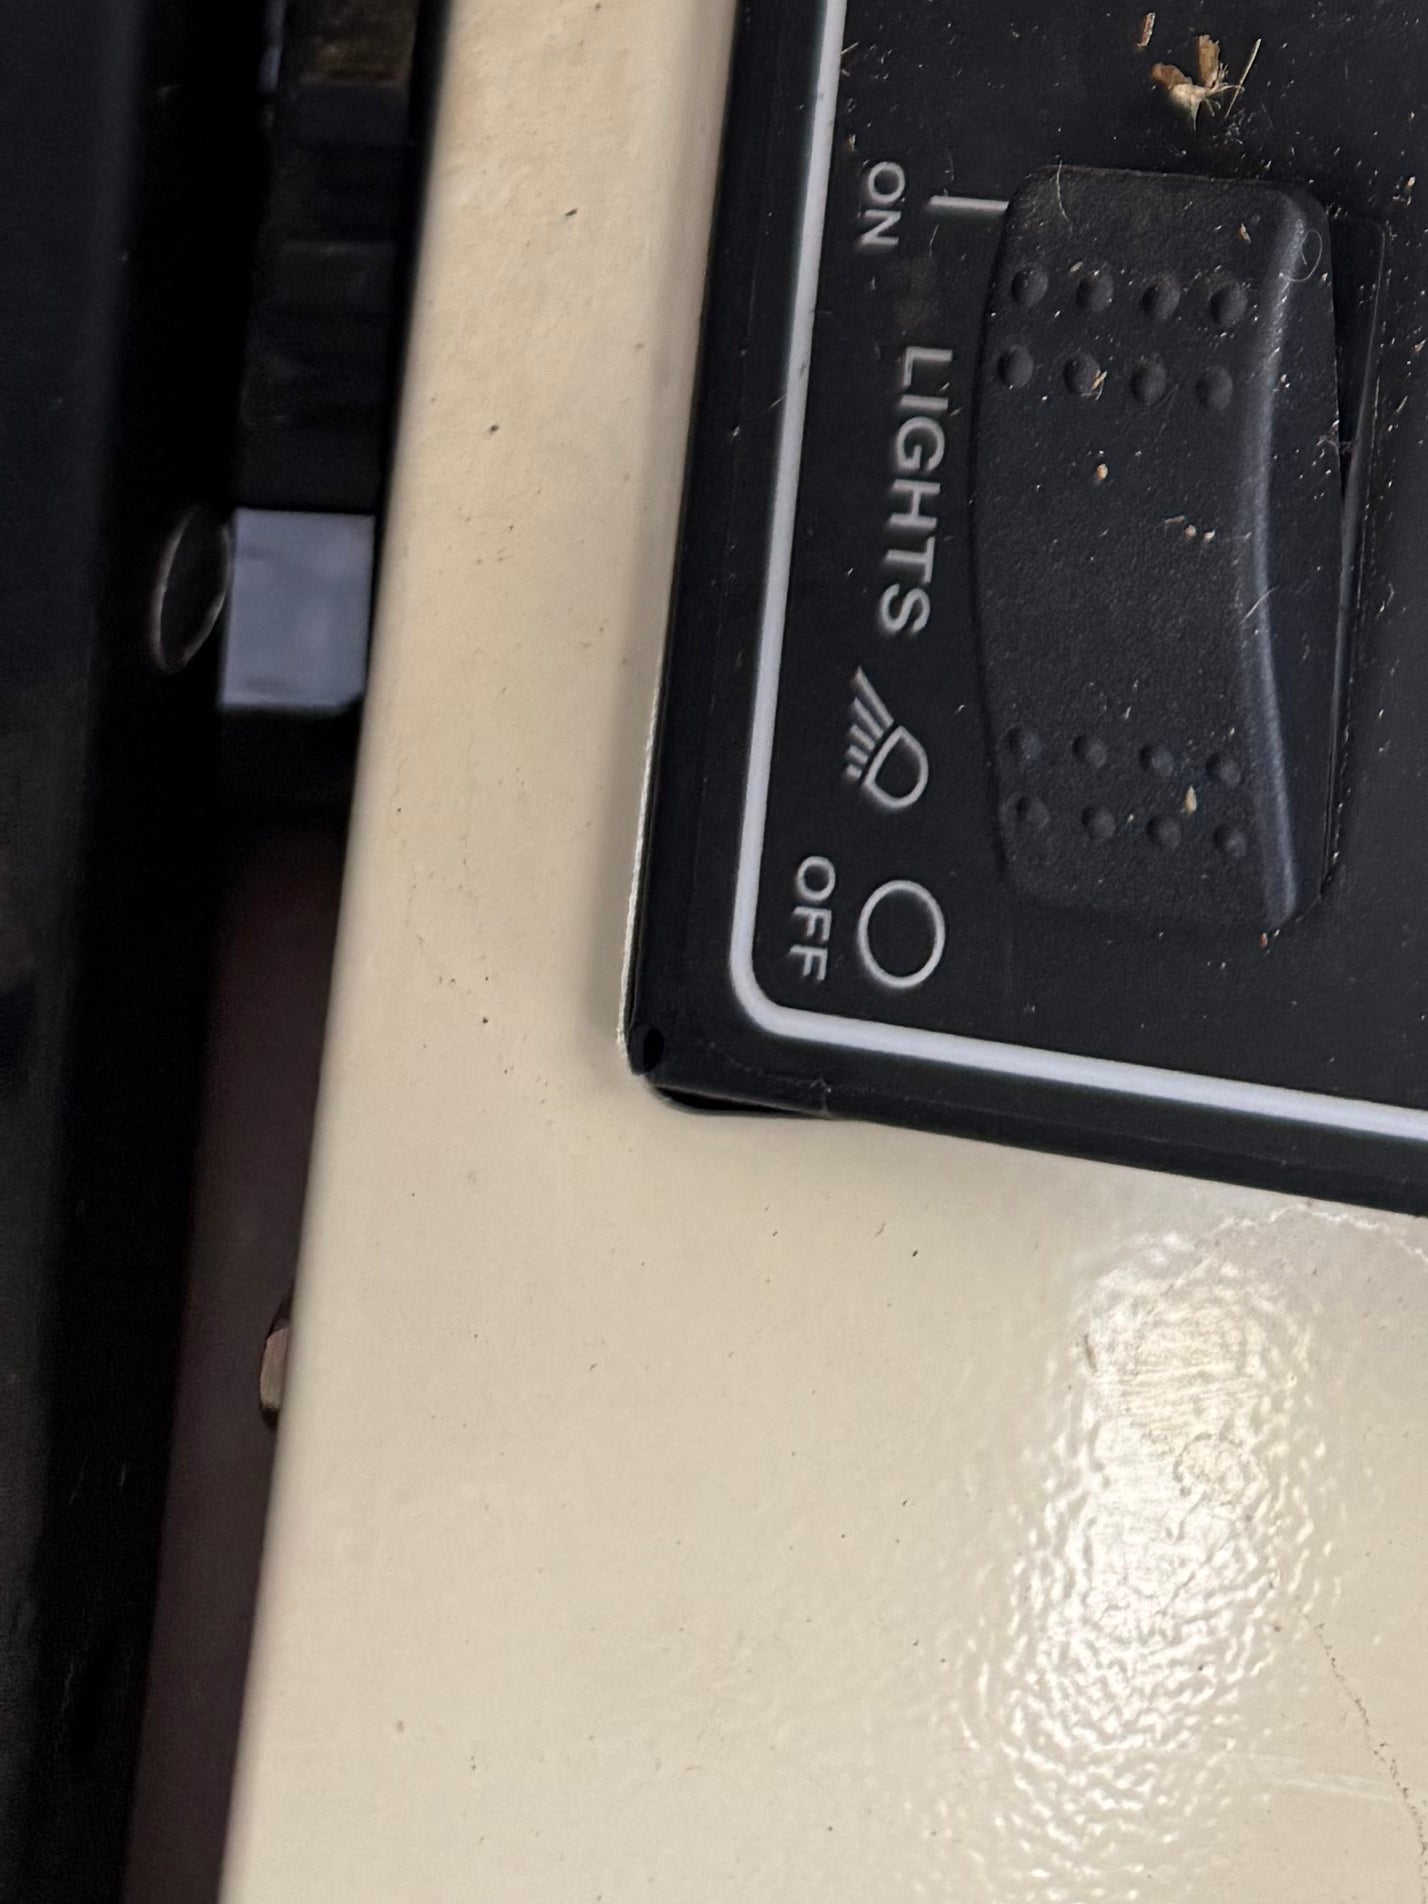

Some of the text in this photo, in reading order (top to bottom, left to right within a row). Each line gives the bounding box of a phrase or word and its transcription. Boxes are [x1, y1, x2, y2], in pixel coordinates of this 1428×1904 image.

[857, 160, 907, 250] ON
[876, 346, 955, 639] LIGHTS
[789, 855, 838, 983] OFF
